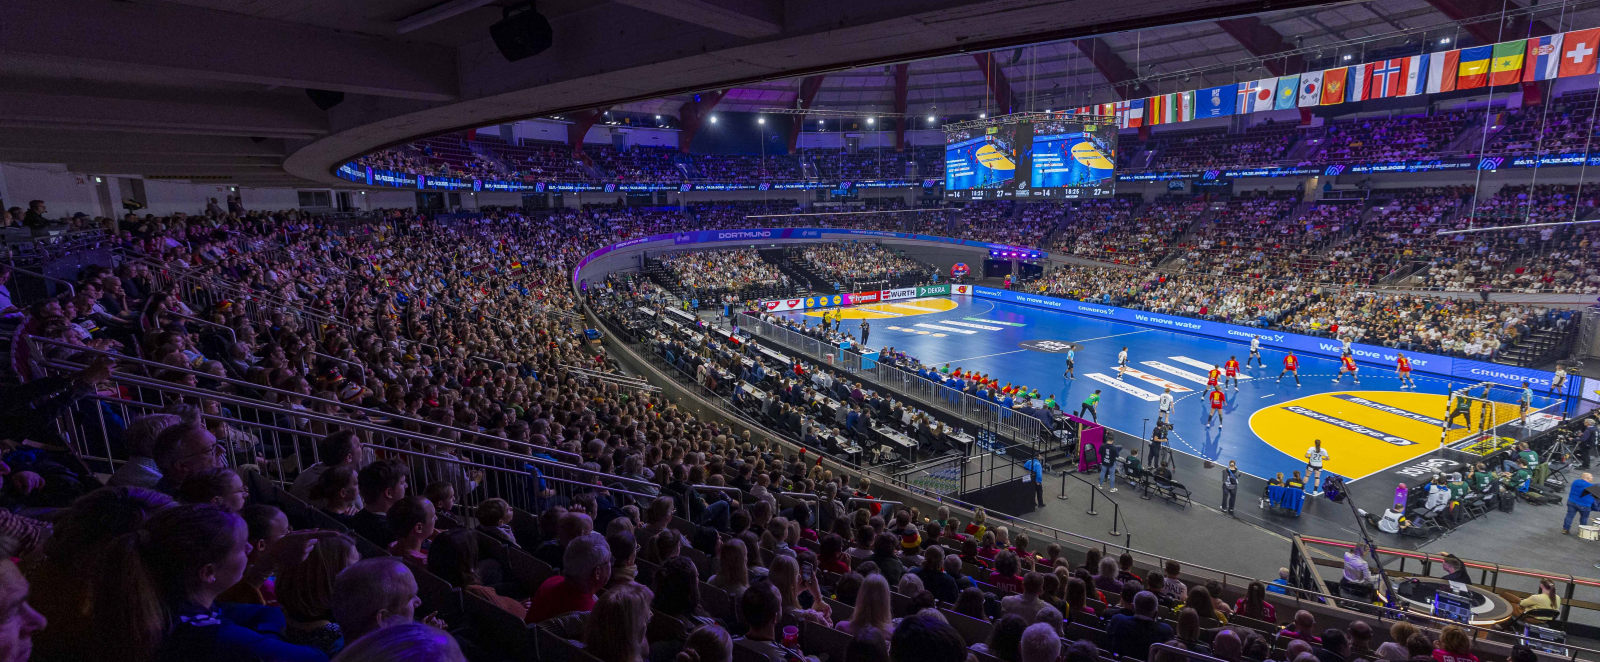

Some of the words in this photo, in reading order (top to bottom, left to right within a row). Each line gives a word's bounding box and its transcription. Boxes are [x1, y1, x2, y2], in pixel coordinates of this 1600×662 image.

[718, 231, 771, 239] DORTMUND
[891, 289, 915, 298] WÜRTH
[1044, 298, 1061, 306] water
[1078, 306, 1108, 314] GRUNDFOS
[1135, 314, 1148, 322] We
[1150, 316, 1172, 326] move
[1175, 320, 1202, 330] water
[1320, 342, 1340, 353] We
[1384, 354, 1428, 367] wter
[1470, 368, 1549, 386] GRUNDFOS
